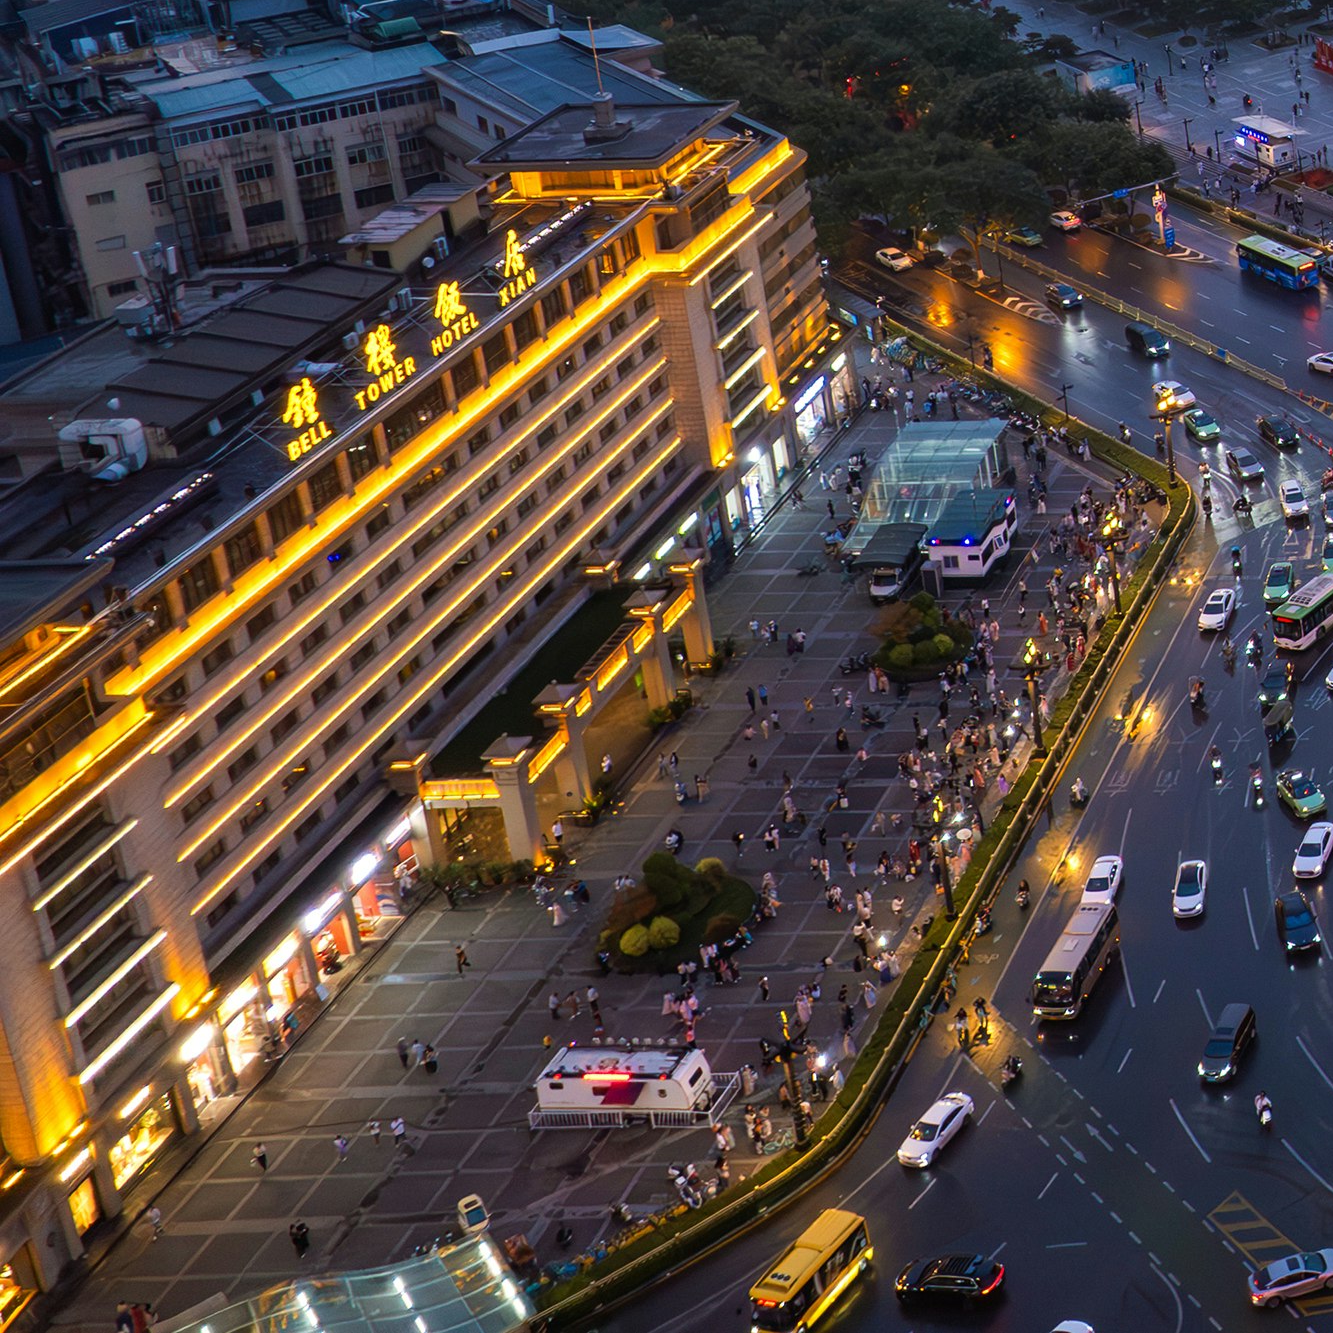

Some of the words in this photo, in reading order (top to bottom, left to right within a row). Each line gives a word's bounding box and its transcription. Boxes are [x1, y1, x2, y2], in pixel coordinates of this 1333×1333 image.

[287, 421, 333, 462] BELL
[353, 356, 417, 411] TOWER
[430, 311, 480, 357] HOTEL
[497, 267, 537, 307] XIAN
